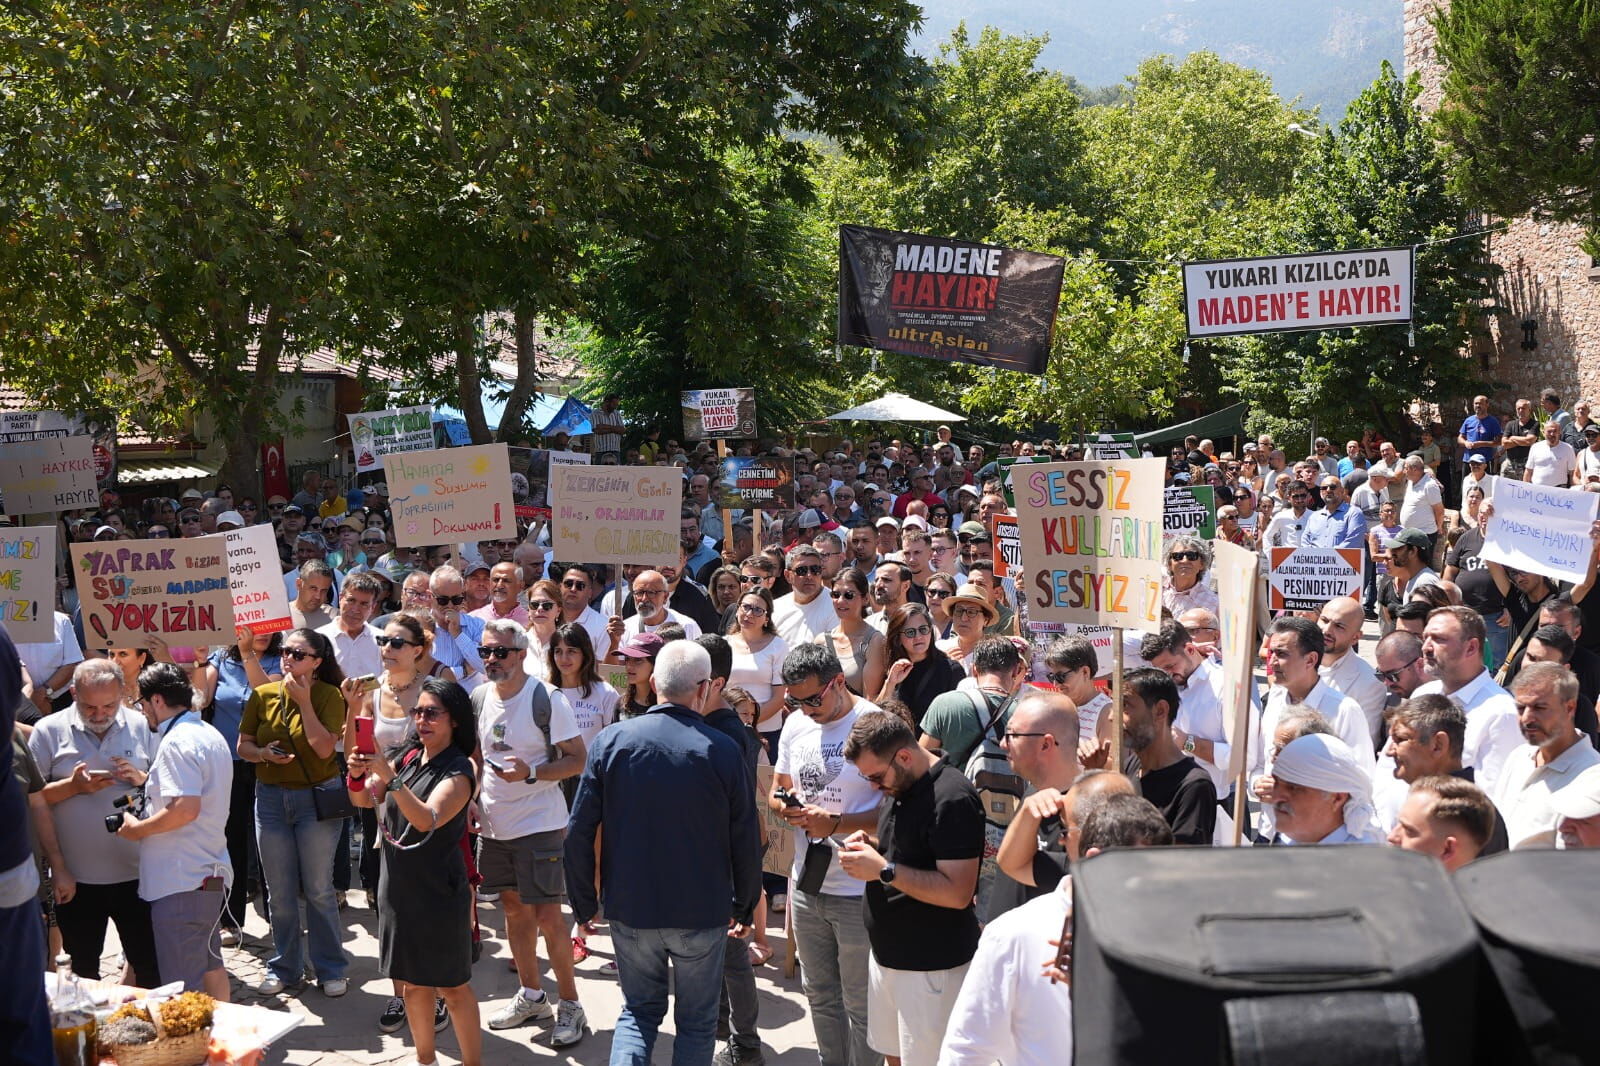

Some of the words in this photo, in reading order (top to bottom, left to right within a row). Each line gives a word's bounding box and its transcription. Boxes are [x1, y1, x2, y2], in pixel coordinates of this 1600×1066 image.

[894, 244, 1002, 276] MADENE
[1205, 265, 1278, 290] YUKARI
[1284, 257, 1391, 284] KIZILCA'DA
[891, 273, 1000, 309] HAYIR!
[1197, 291, 1310, 327] MADEN'E
[1318, 284, 1401, 318] HAYIR!
[888, 326, 989, 352] ultrAslan
[700, 398, 737, 407] KIZILCA'DA
[705, 391, 730, 399] YUKARI
[4, 414, 38, 422] ANAHTAR
[703, 406, 735, 416] MADENE
[704, 415, 737, 428] HAYIR!
[42, 459, 92, 475] HAYKIR
[738, 468, 776, 479] CENNETİMİ
[54, 489, 97, 506] HAYIR
[741, 488, 774, 500] ÇEVİRME
[1028, 466, 1131, 511] SESSİZ
[1507, 484, 1532, 501] TÜM
[224, 532, 243, 542] arı,
[83, 547, 176, 576] YAPRAK
[92, 577, 127, 601] SU
[166, 576, 229, 595] MADENE
[1036, 565, 1129, 613] SESİYİZ
[1283, 577, 1348, 598] PEŞİNDEYİZ!
[103, 602, 160, 633] YOK
